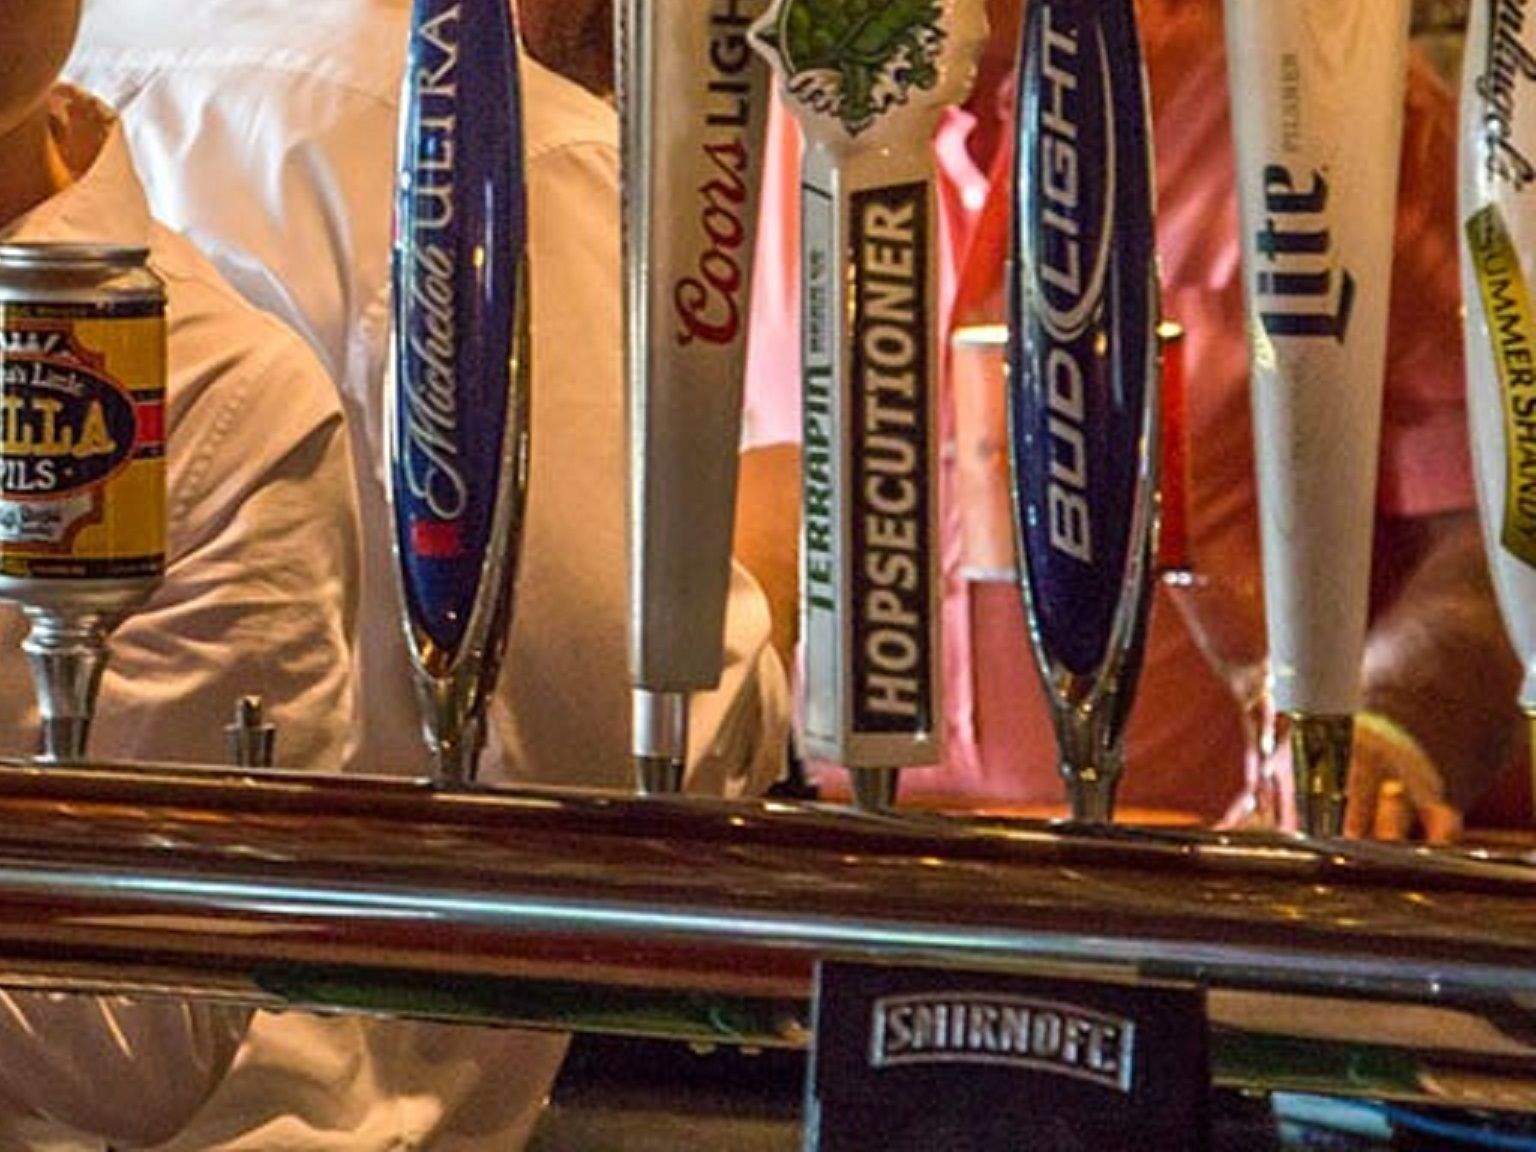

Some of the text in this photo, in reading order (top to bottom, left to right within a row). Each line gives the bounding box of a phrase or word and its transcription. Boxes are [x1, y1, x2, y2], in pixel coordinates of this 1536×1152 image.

[408, 4, 466, 520] Michelob ULTRA
[674, 142, 748, 346] Coors
[1040, 4, 1092, 564] BUD LIGHT
[1257, 164, 1356, 346] Lite
[1478, 233, 1534, 389] SUMMER
[803, 365, 833, 612] TERRAPIN
[865, 198, 918, 716] HOPSECUTIONER
